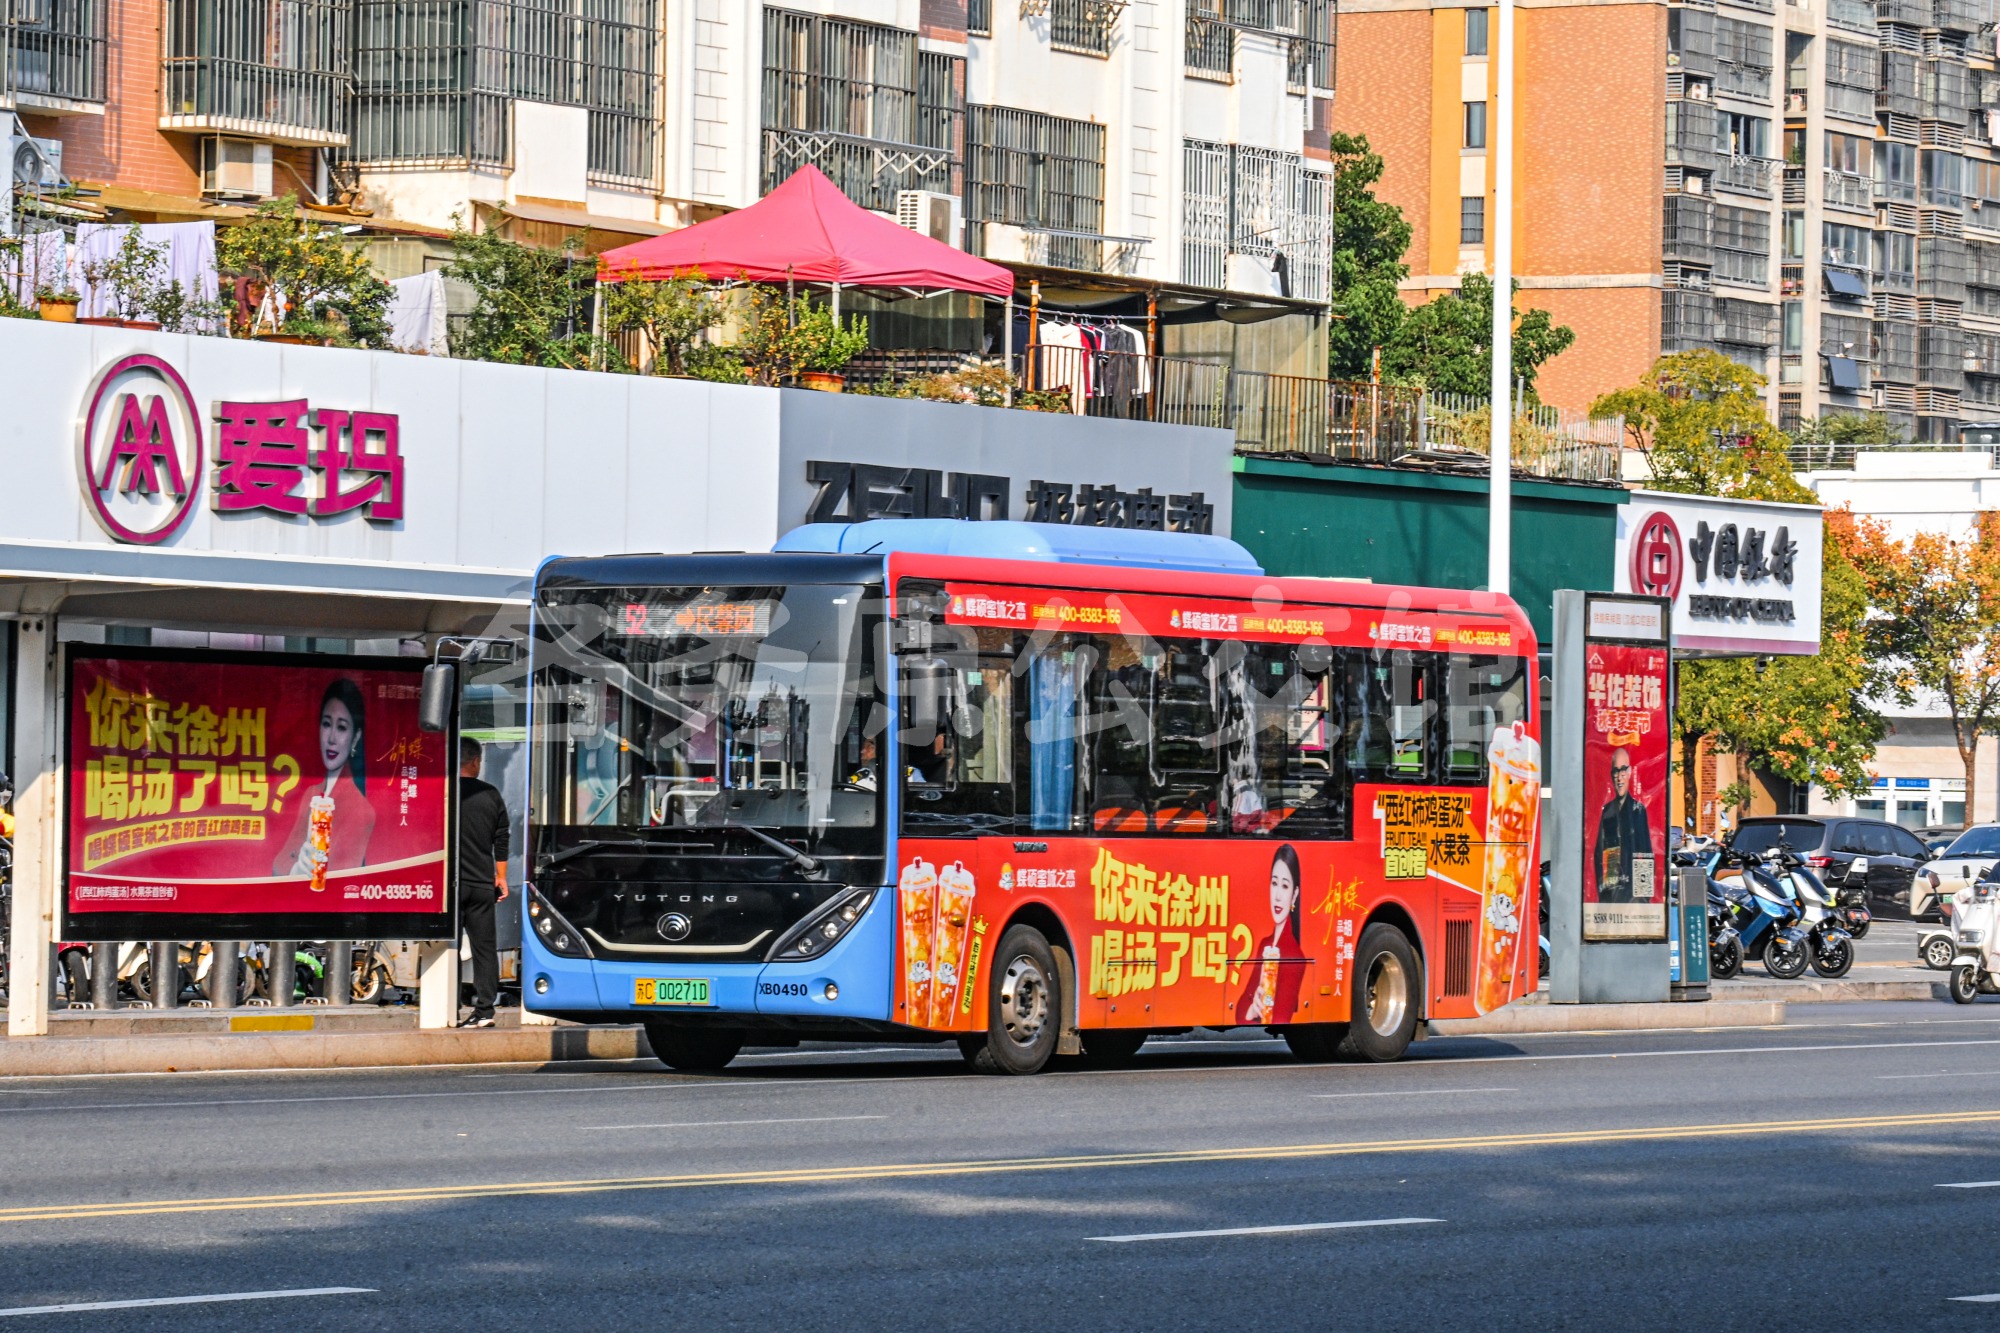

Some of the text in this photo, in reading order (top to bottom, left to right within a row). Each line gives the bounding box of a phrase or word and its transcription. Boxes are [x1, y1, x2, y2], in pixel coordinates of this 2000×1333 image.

[212, 398, 404, 520] 爱玛
[1689, 520, 1798, 584] 中国银行
[626, 604, 647, 635] 52
[1058, 606, 1121, 624] 400-8383-166
[1689, 595, 1796, 620] BANK OF CHINA
[1267, 618, 1324, 636] 400-8383-166
[1458, 630, 1511, 646] 400-8383-166
[1588, 673, 1662, 709] 华佑装饰
[85, 675, 267, 757] 你来徐州
[85, 754, 301, 821] 喝汤了吗?
[1385, 832, 1406, 846] FRUIT
[1430, 833, 1470, 865] 水果茶
[1385, 848, 1427, 878] 首创者
[361, 884, 433, 899] 400-8383-166
[614, 894, 739, 902] YUTONG
[1090, 846, 1229, 927] 你来徐州
[1089, 923, 1253, 998] 喝汤了吗?
[1333, 920, 1343, 997] 品牌创始人
[658, 982, 708, 1000] 00271D
[759, 983, 808, 996] XB0490
